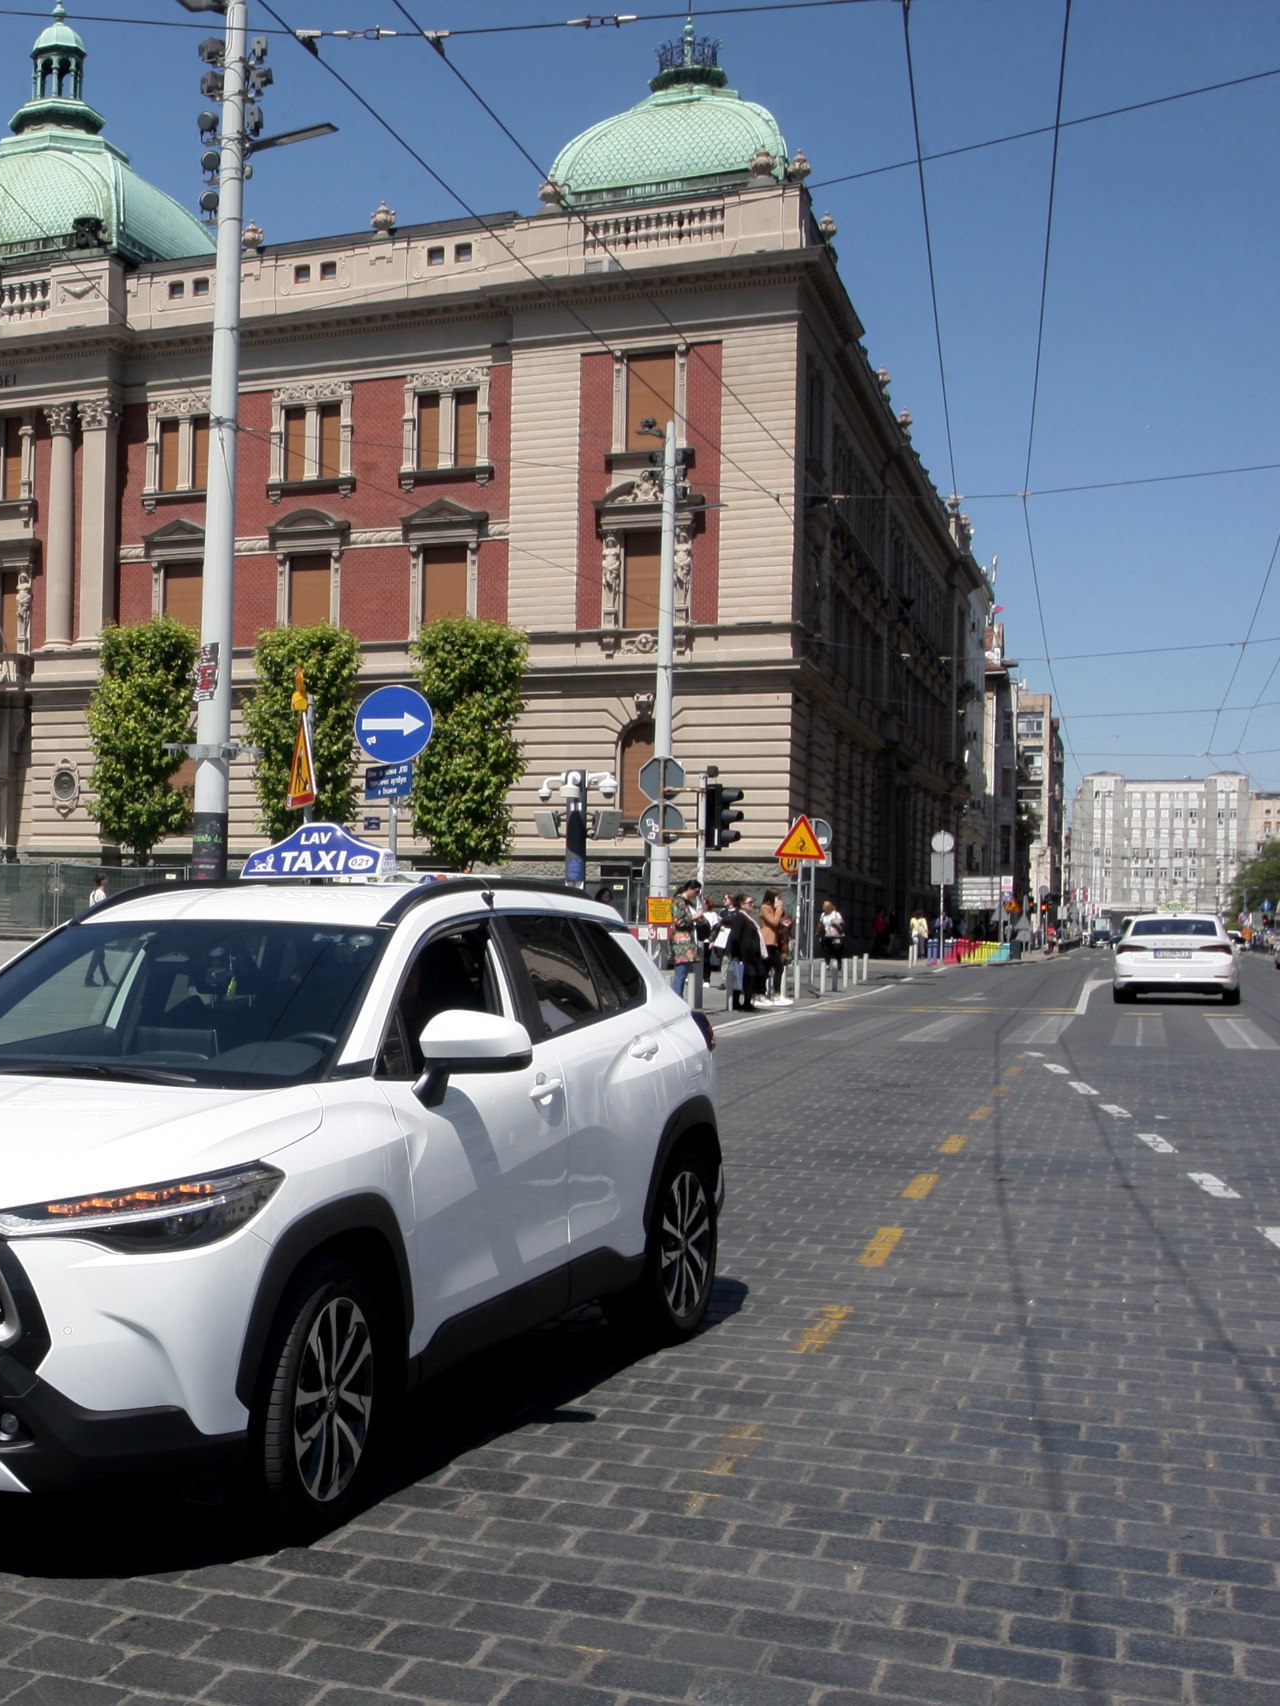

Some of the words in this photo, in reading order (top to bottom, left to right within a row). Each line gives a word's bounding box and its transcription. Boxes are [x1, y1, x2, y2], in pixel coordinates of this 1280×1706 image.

[300, 832, 332, 845] LAV
[281, 850, 348, 873] TAXI
[351, 858, 370, 867] 021
